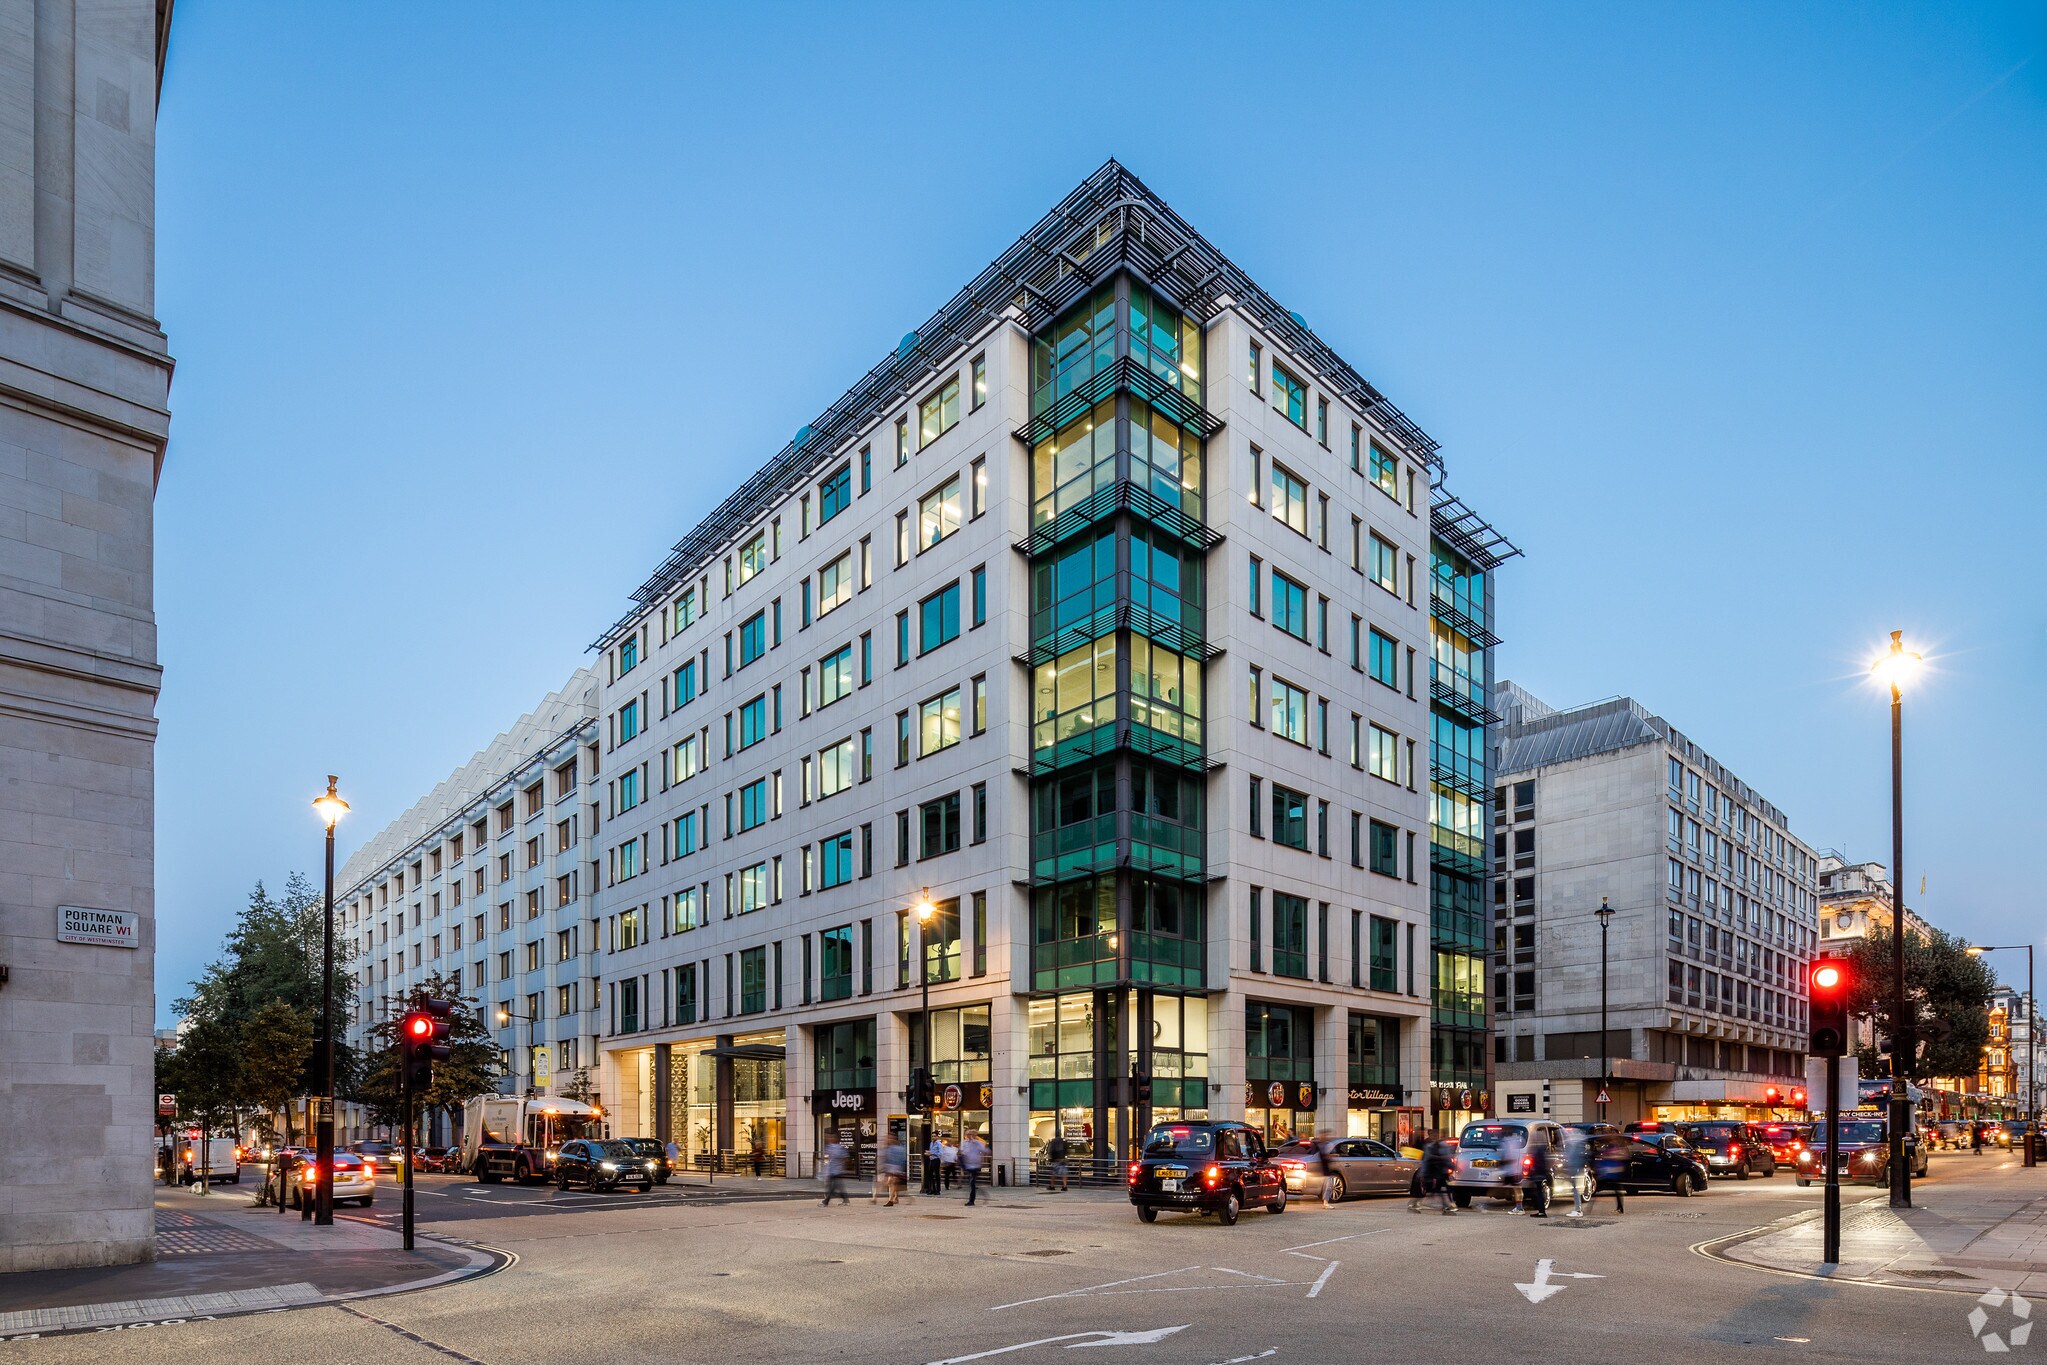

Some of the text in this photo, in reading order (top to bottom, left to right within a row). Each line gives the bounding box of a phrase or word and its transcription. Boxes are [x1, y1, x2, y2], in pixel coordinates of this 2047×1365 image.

[65, 910, 123, 924] PORTMAN
[65, 921, 132, 936] SQUARE W1
[87, 937, 125, 945] WESTMINSTER
[832, 1090, 862, 1111] Jeep
[1363, 1089, 1395, 1107] Village
[96, 1316, 217, 1332] LOOK
